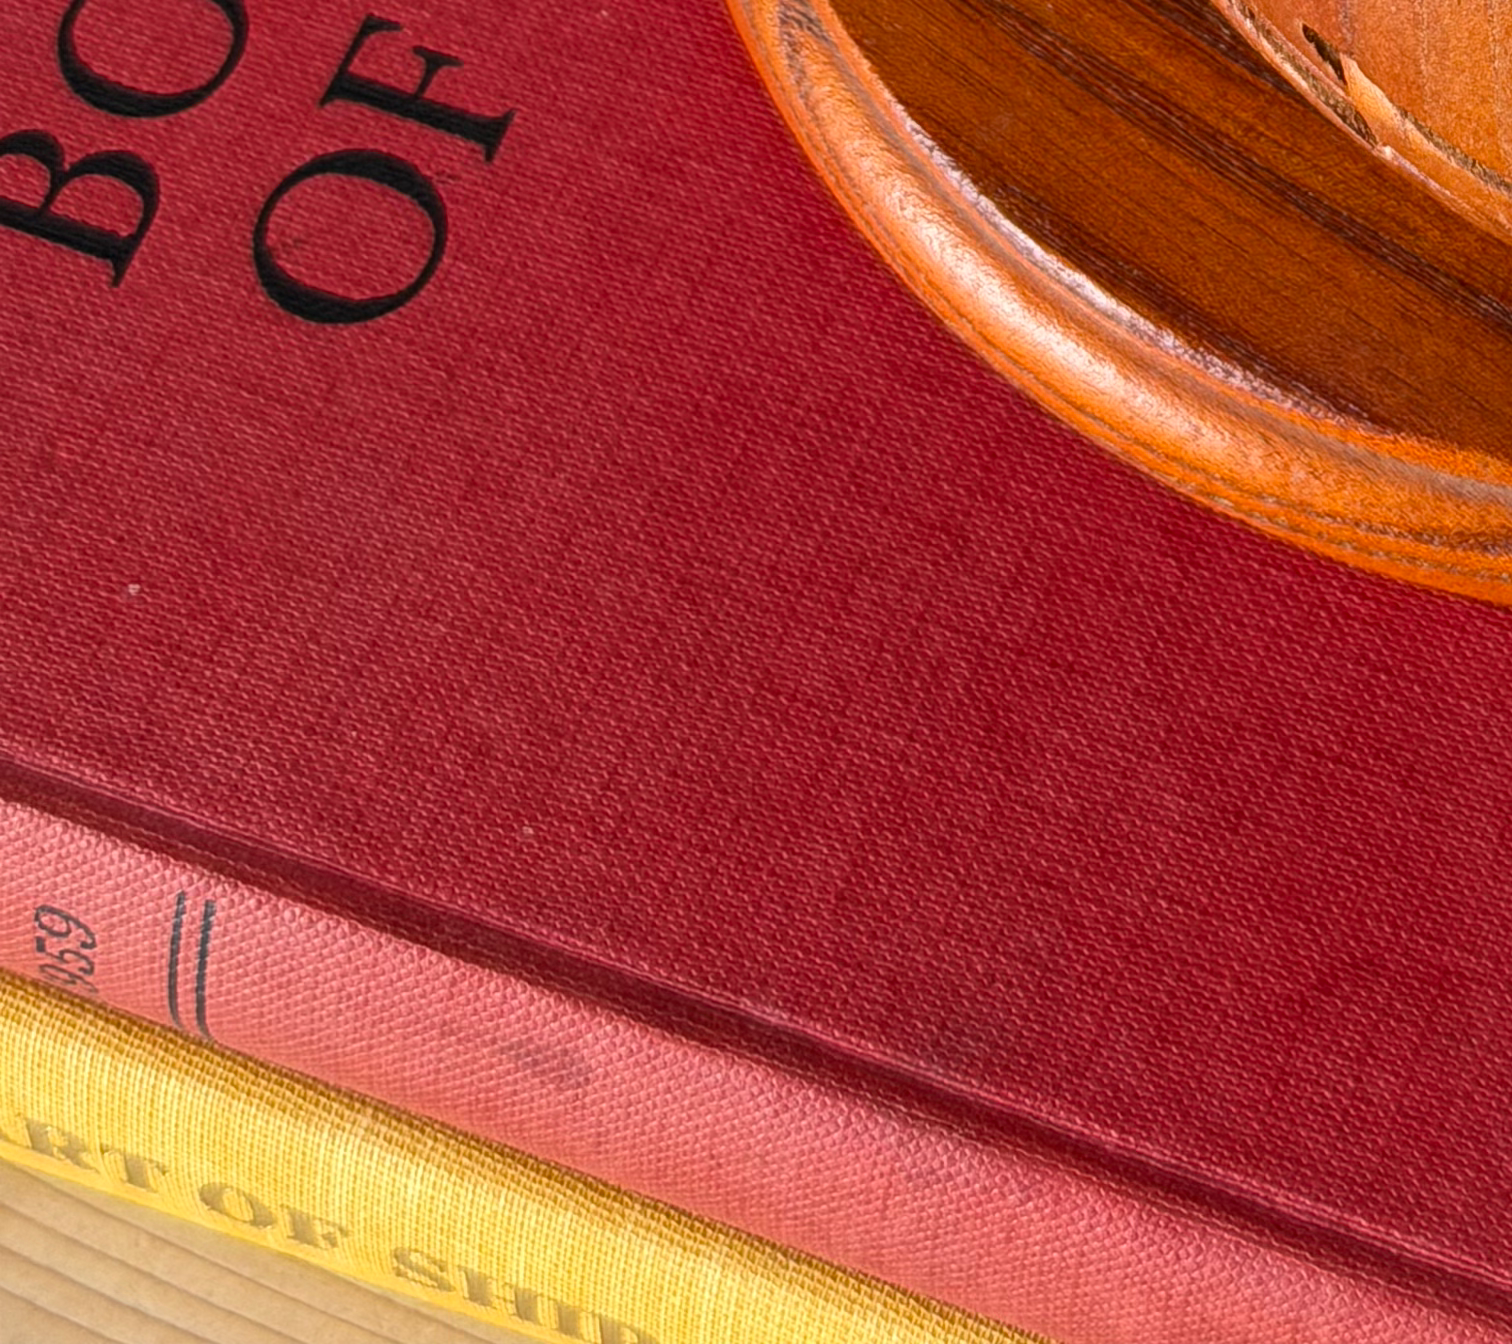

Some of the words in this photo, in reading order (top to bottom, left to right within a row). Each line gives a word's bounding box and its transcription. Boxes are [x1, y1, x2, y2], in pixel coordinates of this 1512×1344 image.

[252, 14, 515, 325] OF
[0, 1114, 170, 1194] RT
[199, 1181, 352, 1251] OF
